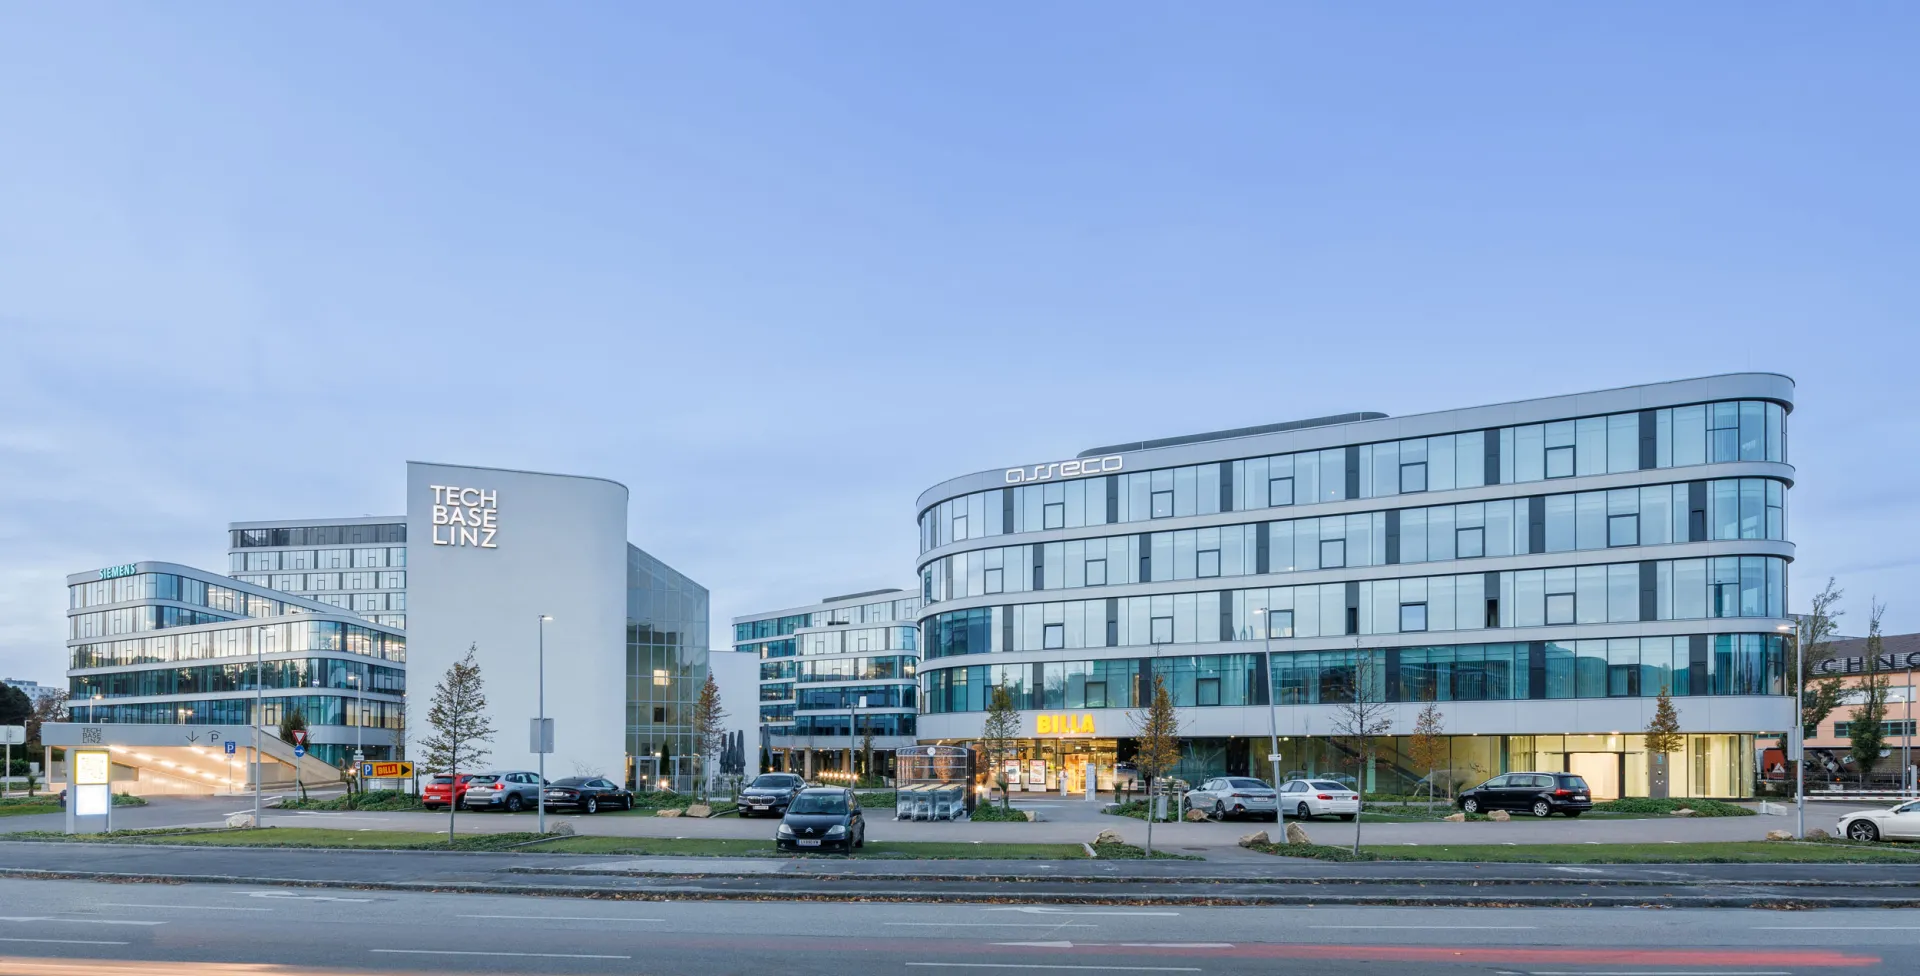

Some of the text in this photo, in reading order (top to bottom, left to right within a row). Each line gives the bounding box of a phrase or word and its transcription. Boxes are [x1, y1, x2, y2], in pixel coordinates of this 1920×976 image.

[1005, 455, 1123, 483] asseco
[430, 485, 497, 508] TECH
[433, 504, 497, 528] BASE
[433, 525, 497, 548] LINZ
[99, 563, 136, 580] SIEMENS
[1037, 713, 1095, 734] BILLA
[211, 733, 219, 743] P
[227, 744, 234, 753] P
[364, 764, 397, 775] P BILLA
